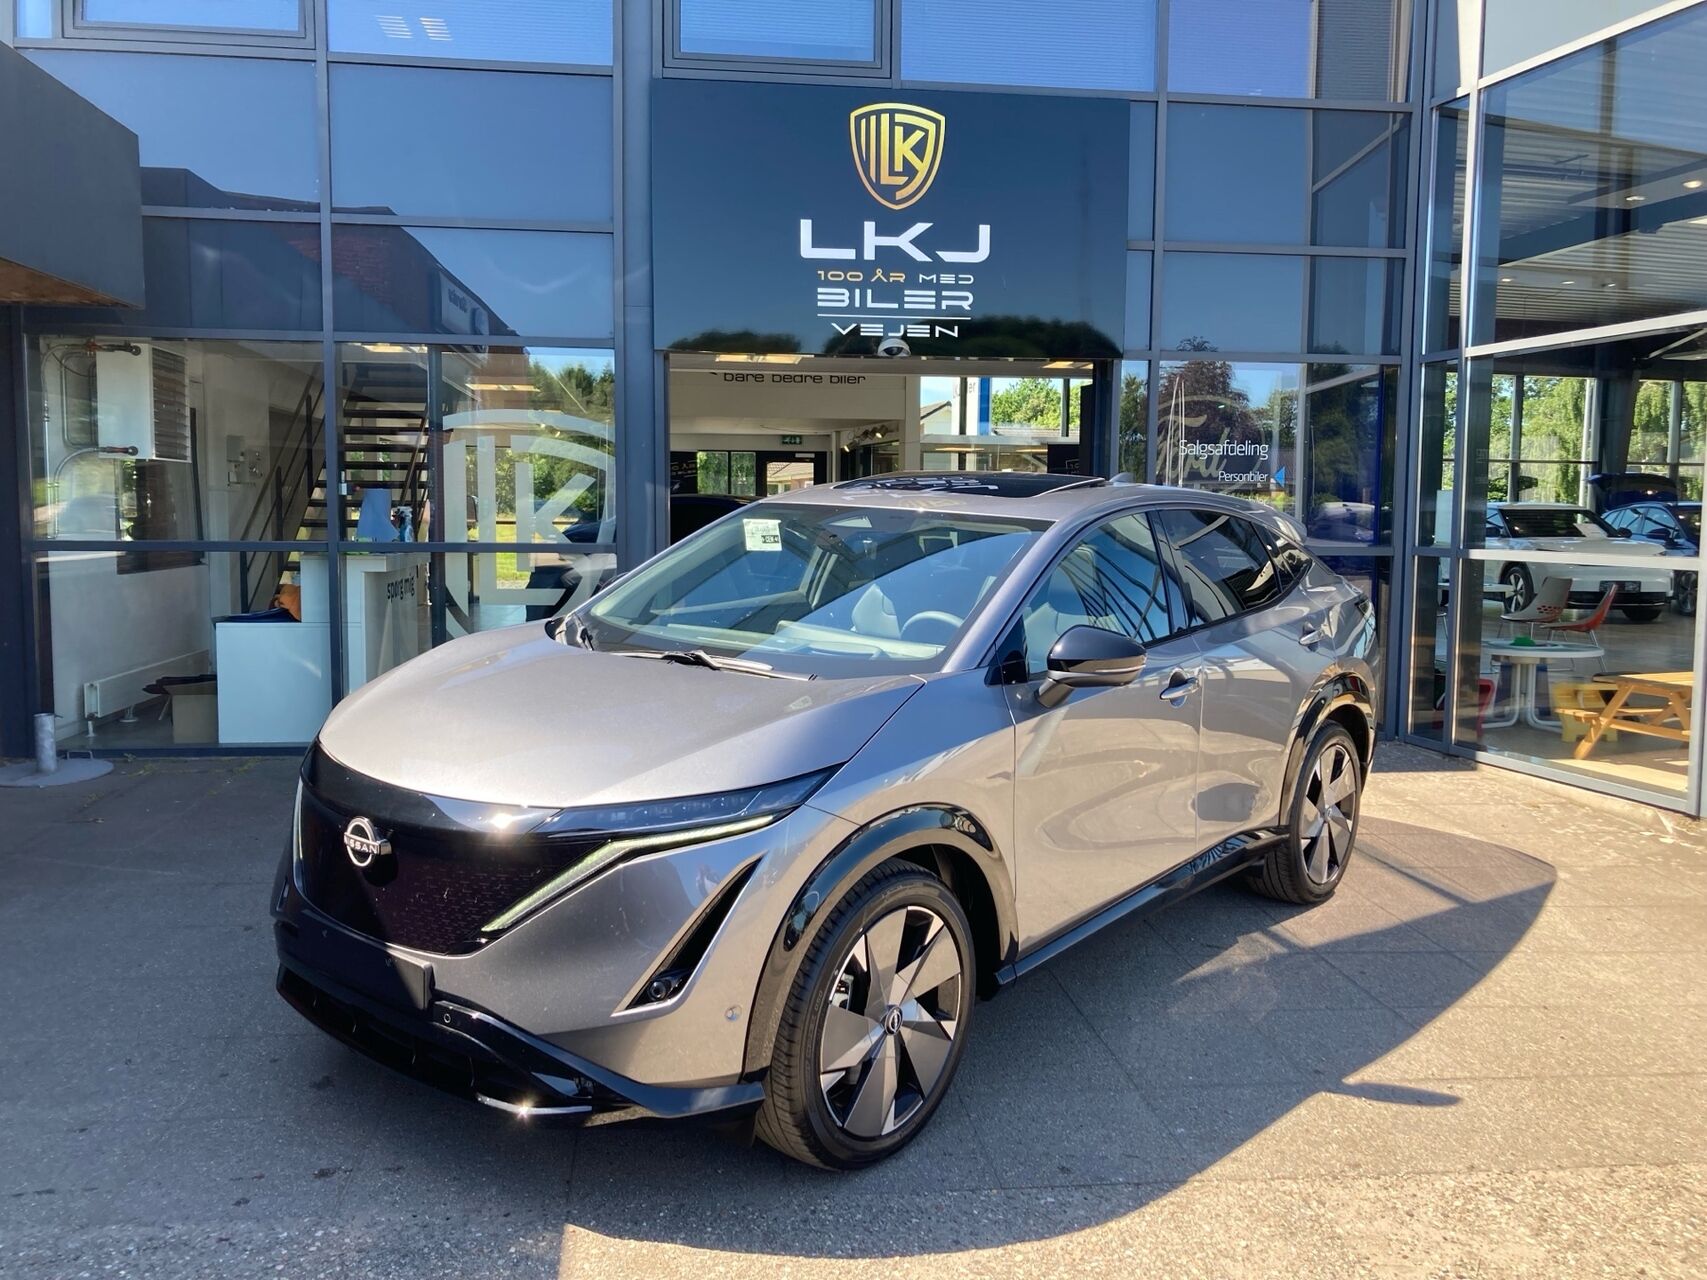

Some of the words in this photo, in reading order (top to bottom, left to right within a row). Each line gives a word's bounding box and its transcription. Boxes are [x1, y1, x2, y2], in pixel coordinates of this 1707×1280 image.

[800, 219, 990, 263] LKJ
[817, 270, 863, 282] 100
[870, 268, 906, 283] ÅR
[919, 273, 974, 284] MED
[817, 287, 974, 310] BILER
[831, 323, 959, 338] VEJEN
[723, 372, 764, 383] bare
[1179, 439, 1269, 460] Salgsafdeling
[1218, 471, 1268, 482] Personbiler
